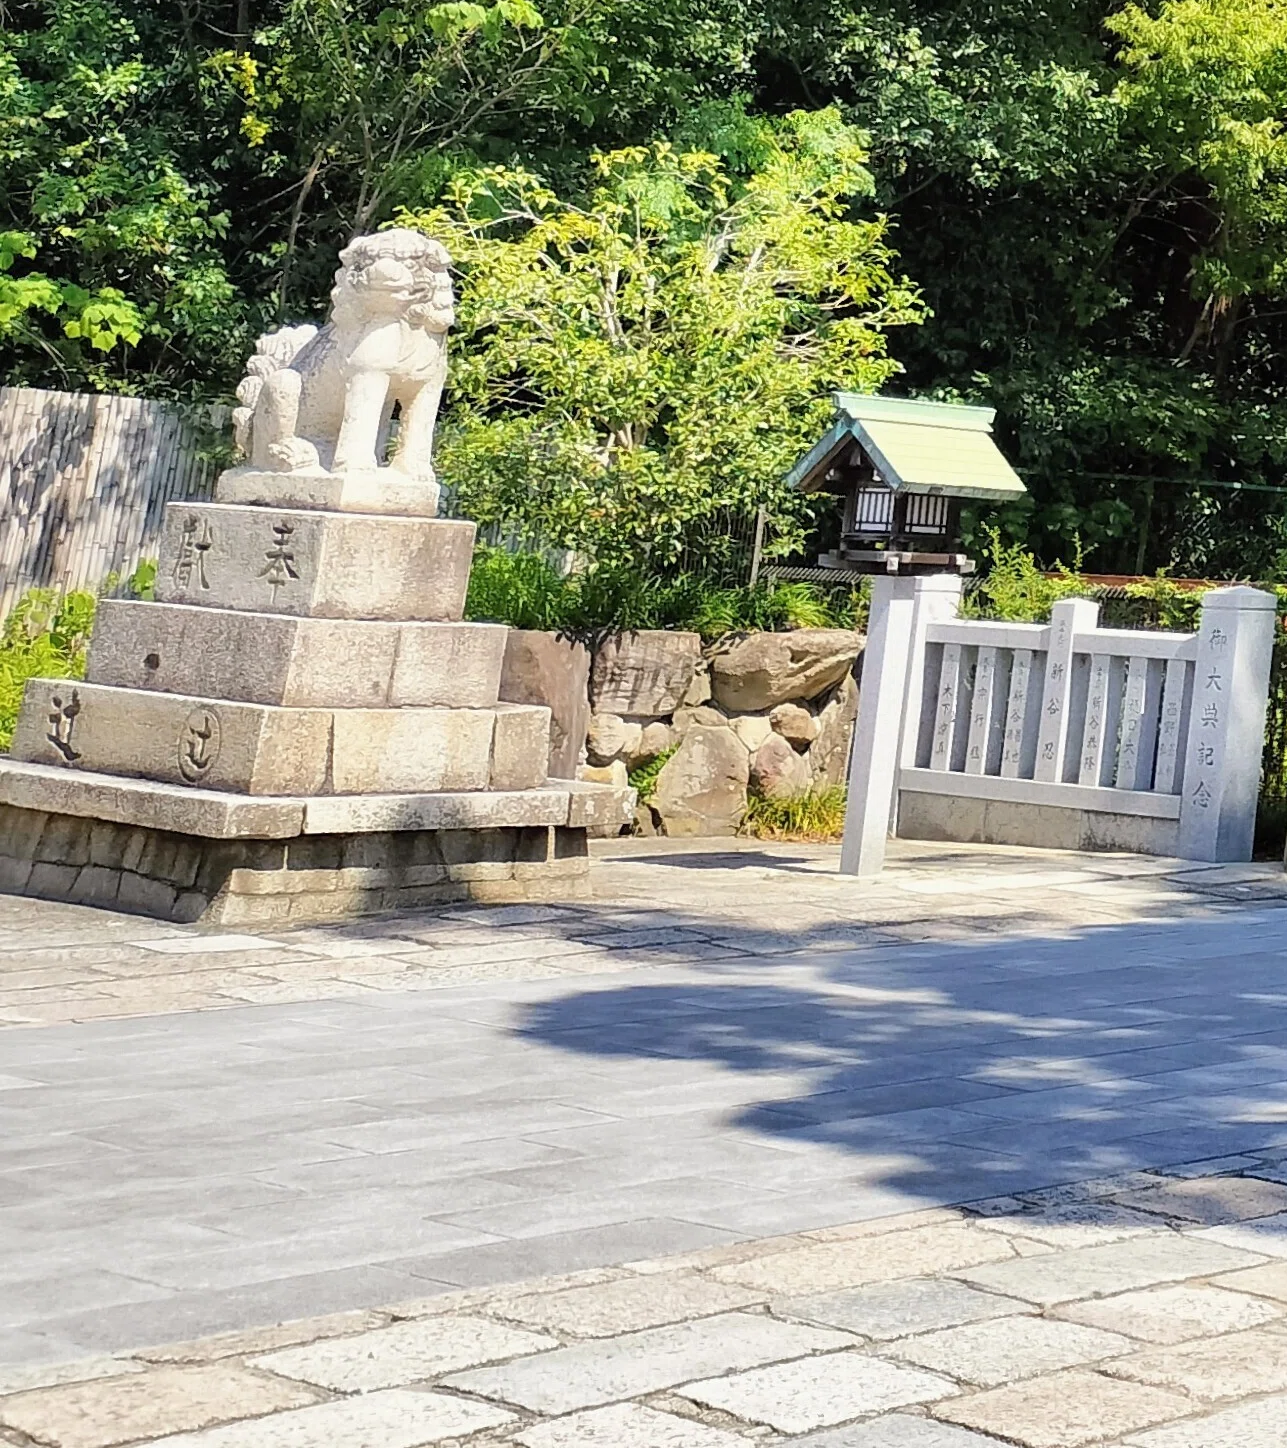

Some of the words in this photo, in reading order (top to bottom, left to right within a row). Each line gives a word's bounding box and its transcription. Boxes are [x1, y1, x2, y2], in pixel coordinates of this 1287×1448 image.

[1192, 628, 1228, 809] 御大典記念
